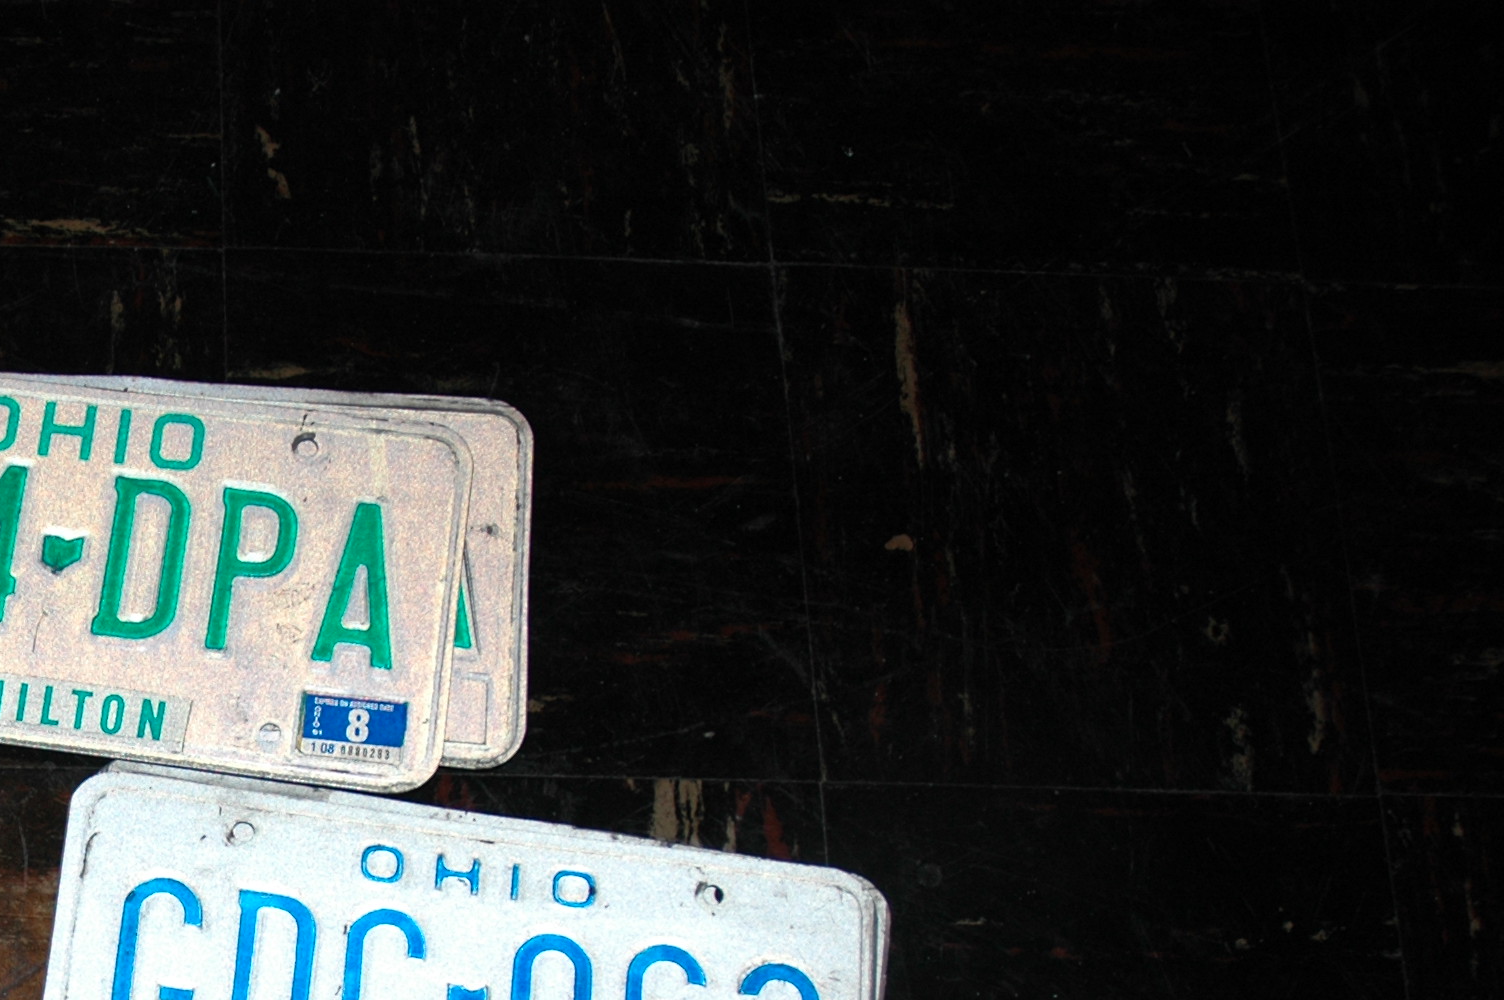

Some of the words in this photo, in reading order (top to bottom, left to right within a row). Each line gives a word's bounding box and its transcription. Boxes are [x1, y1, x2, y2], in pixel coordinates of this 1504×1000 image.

[345, 708, 370, 743] 8
[320, 743, 334, 754] 08
[361, 844, 596, 909] OHIO
